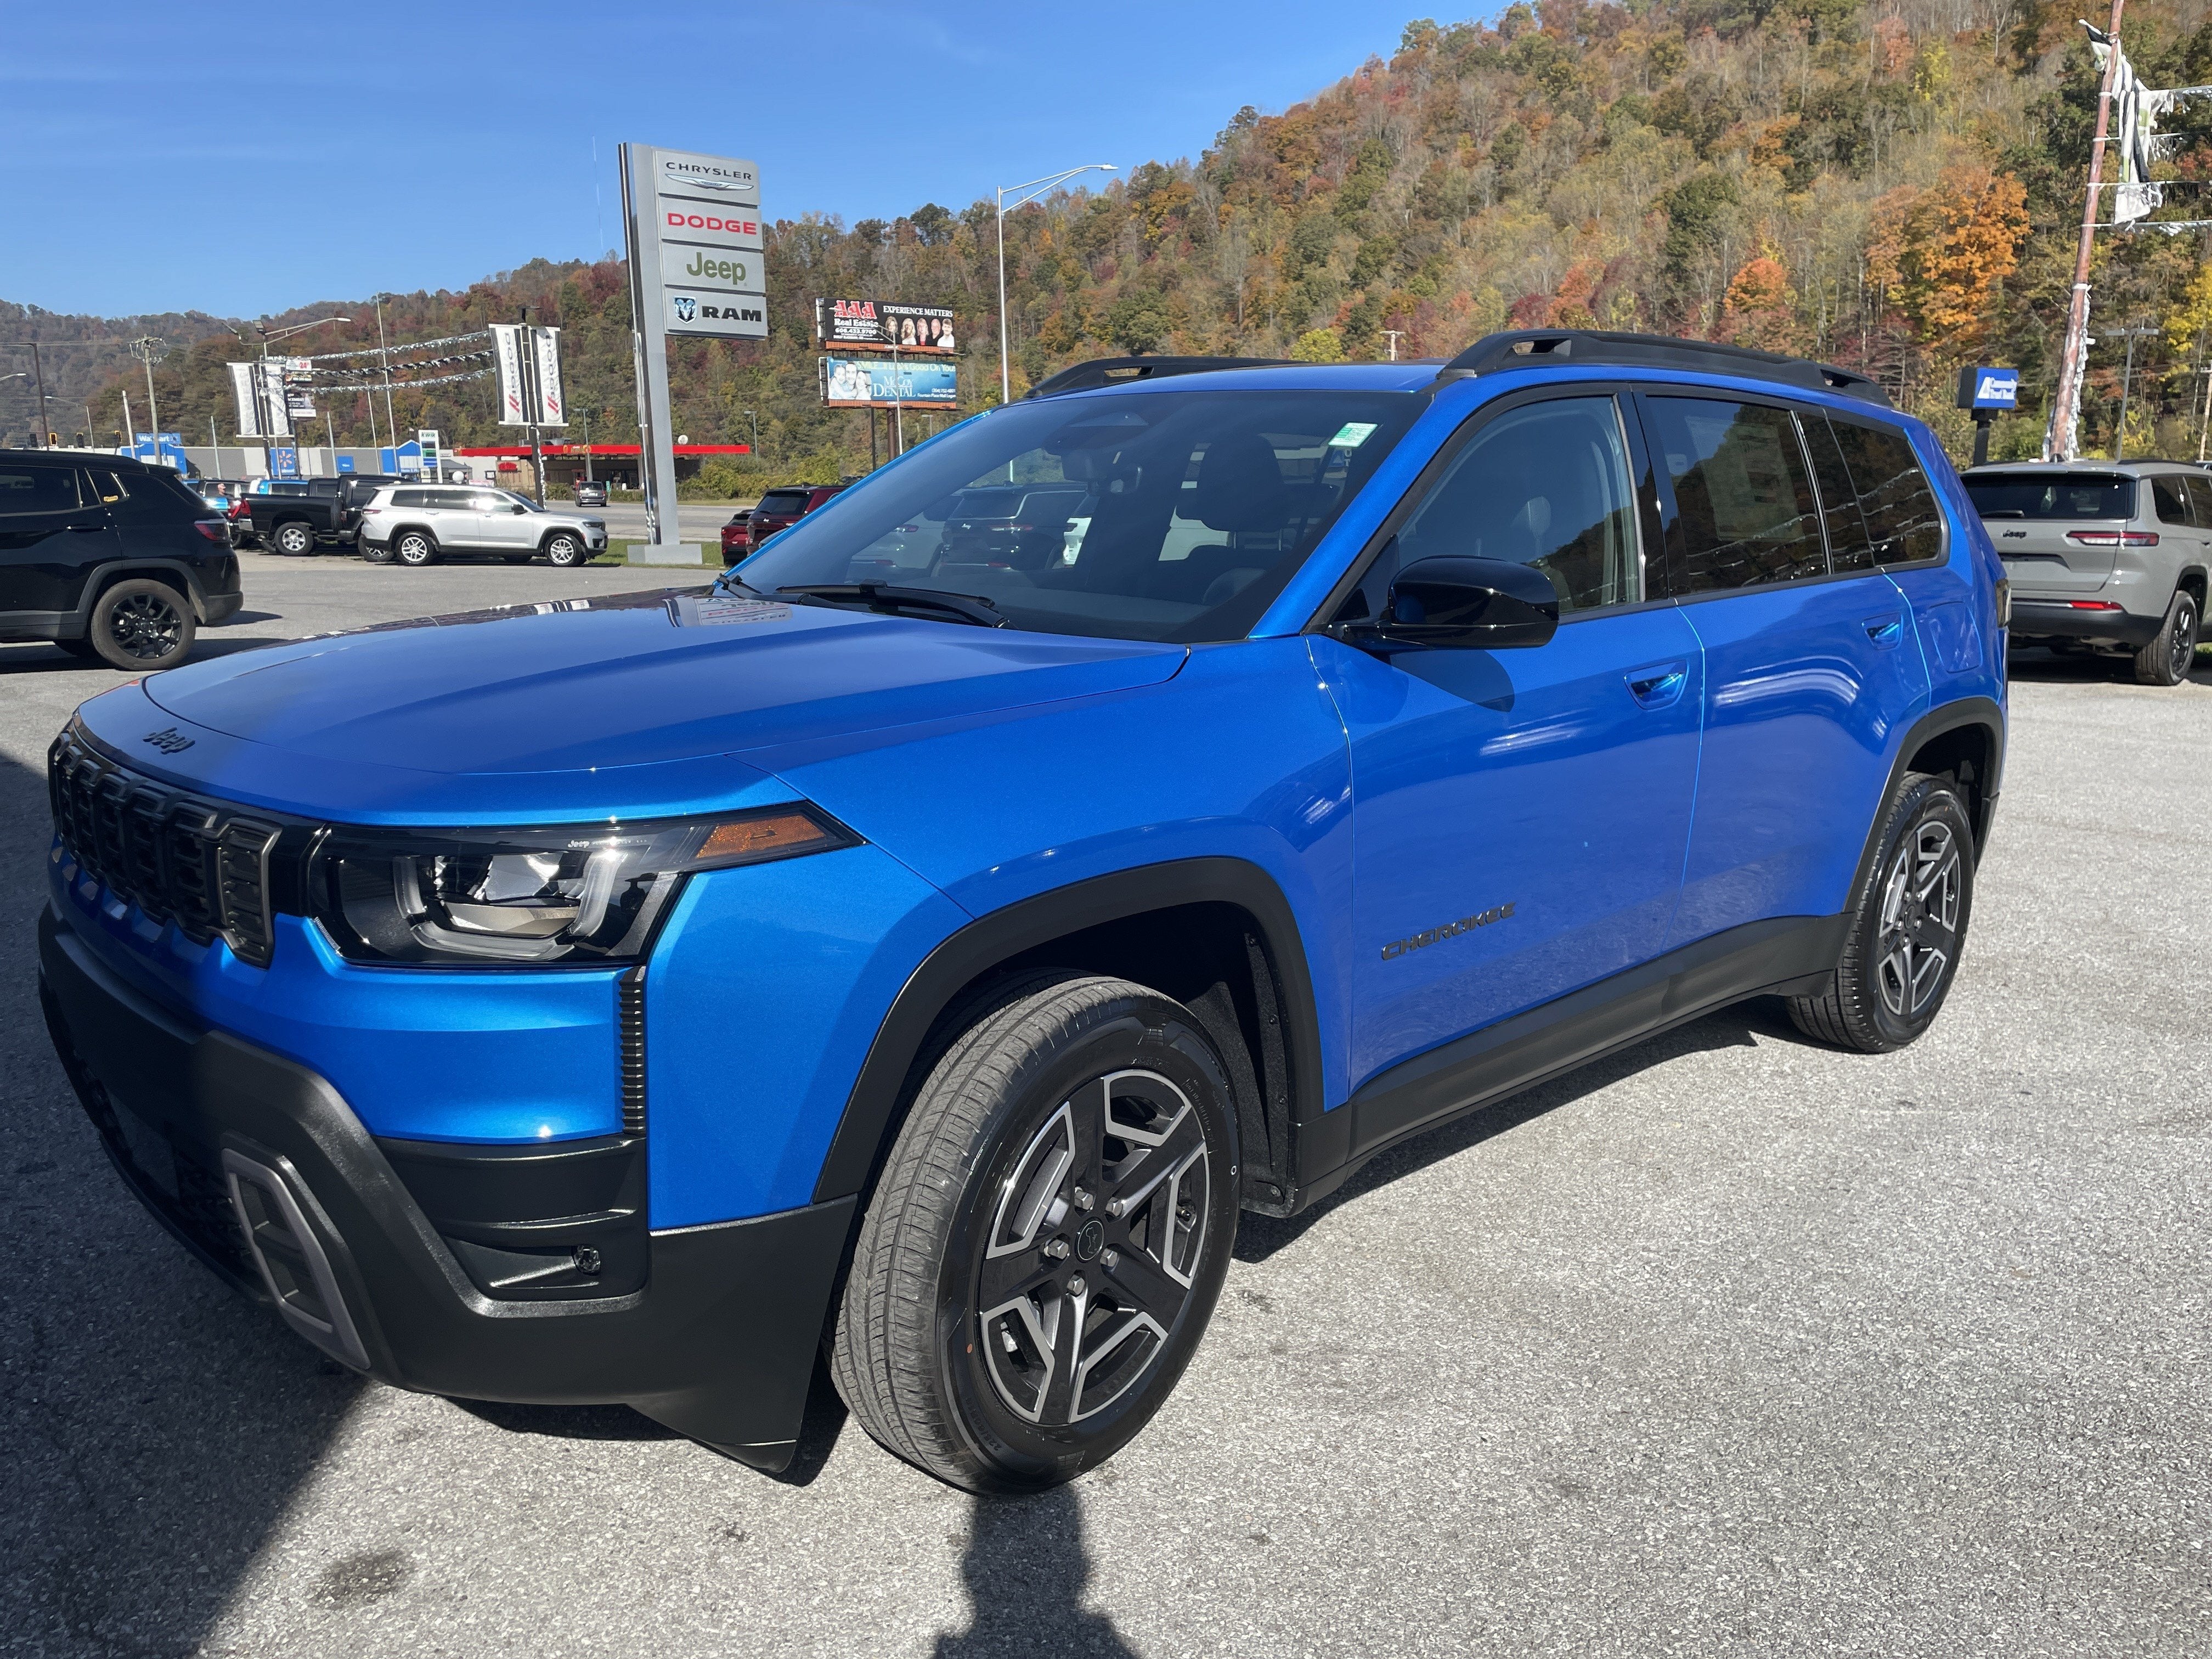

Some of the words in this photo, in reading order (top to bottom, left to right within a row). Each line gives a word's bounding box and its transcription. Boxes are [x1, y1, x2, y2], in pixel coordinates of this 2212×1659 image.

[666, 162, 752, 180] CHRYSLER
[667, 212, 757, 235] DODGE
[686, 252, 746, 285] Jeep
[702, 306, 761, 321] RAM
[833, 300, 878, 319] AAA
[883, 305, 924, 314] EXPERIENCE
[924, 308, 953, 317] MATTERS
[834, 318, 852, 326] Real
[910, 363, 929, 371] Good
[873, 383, 916, 397] DENTAL
[2002, 529, 2027, 539] Jeep
[142, 727, 195, 755] Jeep
[568, 840, 590, 848] Jeep
[1381, 901, 1516, 961] CHEROKEE
